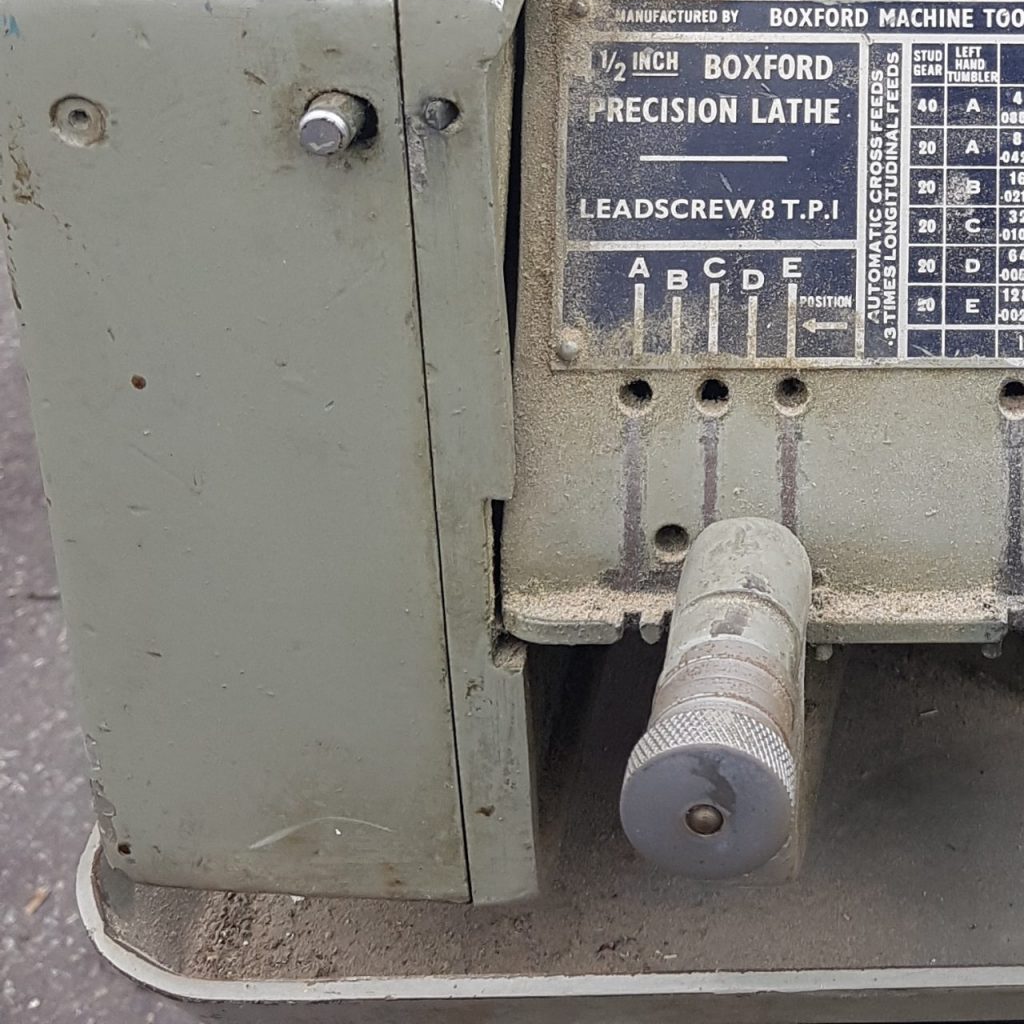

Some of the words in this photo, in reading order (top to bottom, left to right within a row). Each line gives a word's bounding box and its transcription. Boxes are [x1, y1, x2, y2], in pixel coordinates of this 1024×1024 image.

[615, 9, 718, 24] MANUFACTURED
[721, 9, 739, 24] BY
[770, 7, 870, 28] BOXFORD
[879, 9, 974, 29] MACHINE
[913, 50, 943, 62] STUD
[955, 46, 982, 58] LEFT
[632, 51, 679, 72] INCH
[705, 54, 834, 80] BOXFORD
[913, 64, 943, 76] GEAR
[955, 59, 985, 71] HAND
[887, 51, 899, 114] FEEDS
[947, 71, 999, 83] TUMBLER
[870, 69, 884, 132] FEEDS
[918, 98, 938, 112] 40
[966, 98, 980, 112] A
[1013, 91, 1022, 105] 4
[589, 97, 738, 124] PRECISION
[752, 98, 841, 125] LATHE
[1013, 132, 1022, 146] 8
[918, 140, 936, 154] 20
[965, 140, 980, 154] A
[869, 136, 884, 203] CROSS
[884, 117, 899, 260] LONGITUDINAL
[918, 180, 936, 194] 20
[967, 180, 980, 194] B
[580, 199, 754, 220] LEADSCREW
[761, 199, 776, 220] 8
[918, 219, 936, 233] 20
[965, 219, 980, 233] C
[867, 208, 883, 324] AUTOMATIC
[918, 259, 936, 273] 20
[965, 259, 980, 273] D
[629, 257, 651, 278] A
[667, 270, 689, 291] B
[703, 257, 726, 277] C
[743, 269, 765, 290] D
[783, 257, 802, 278] E
[883, 266, 897, 324] TIMES
[800, 296, 853, 309] POSITION
[966, 299, 980, 313] E
[1018, 335, 1024, 351] 1
